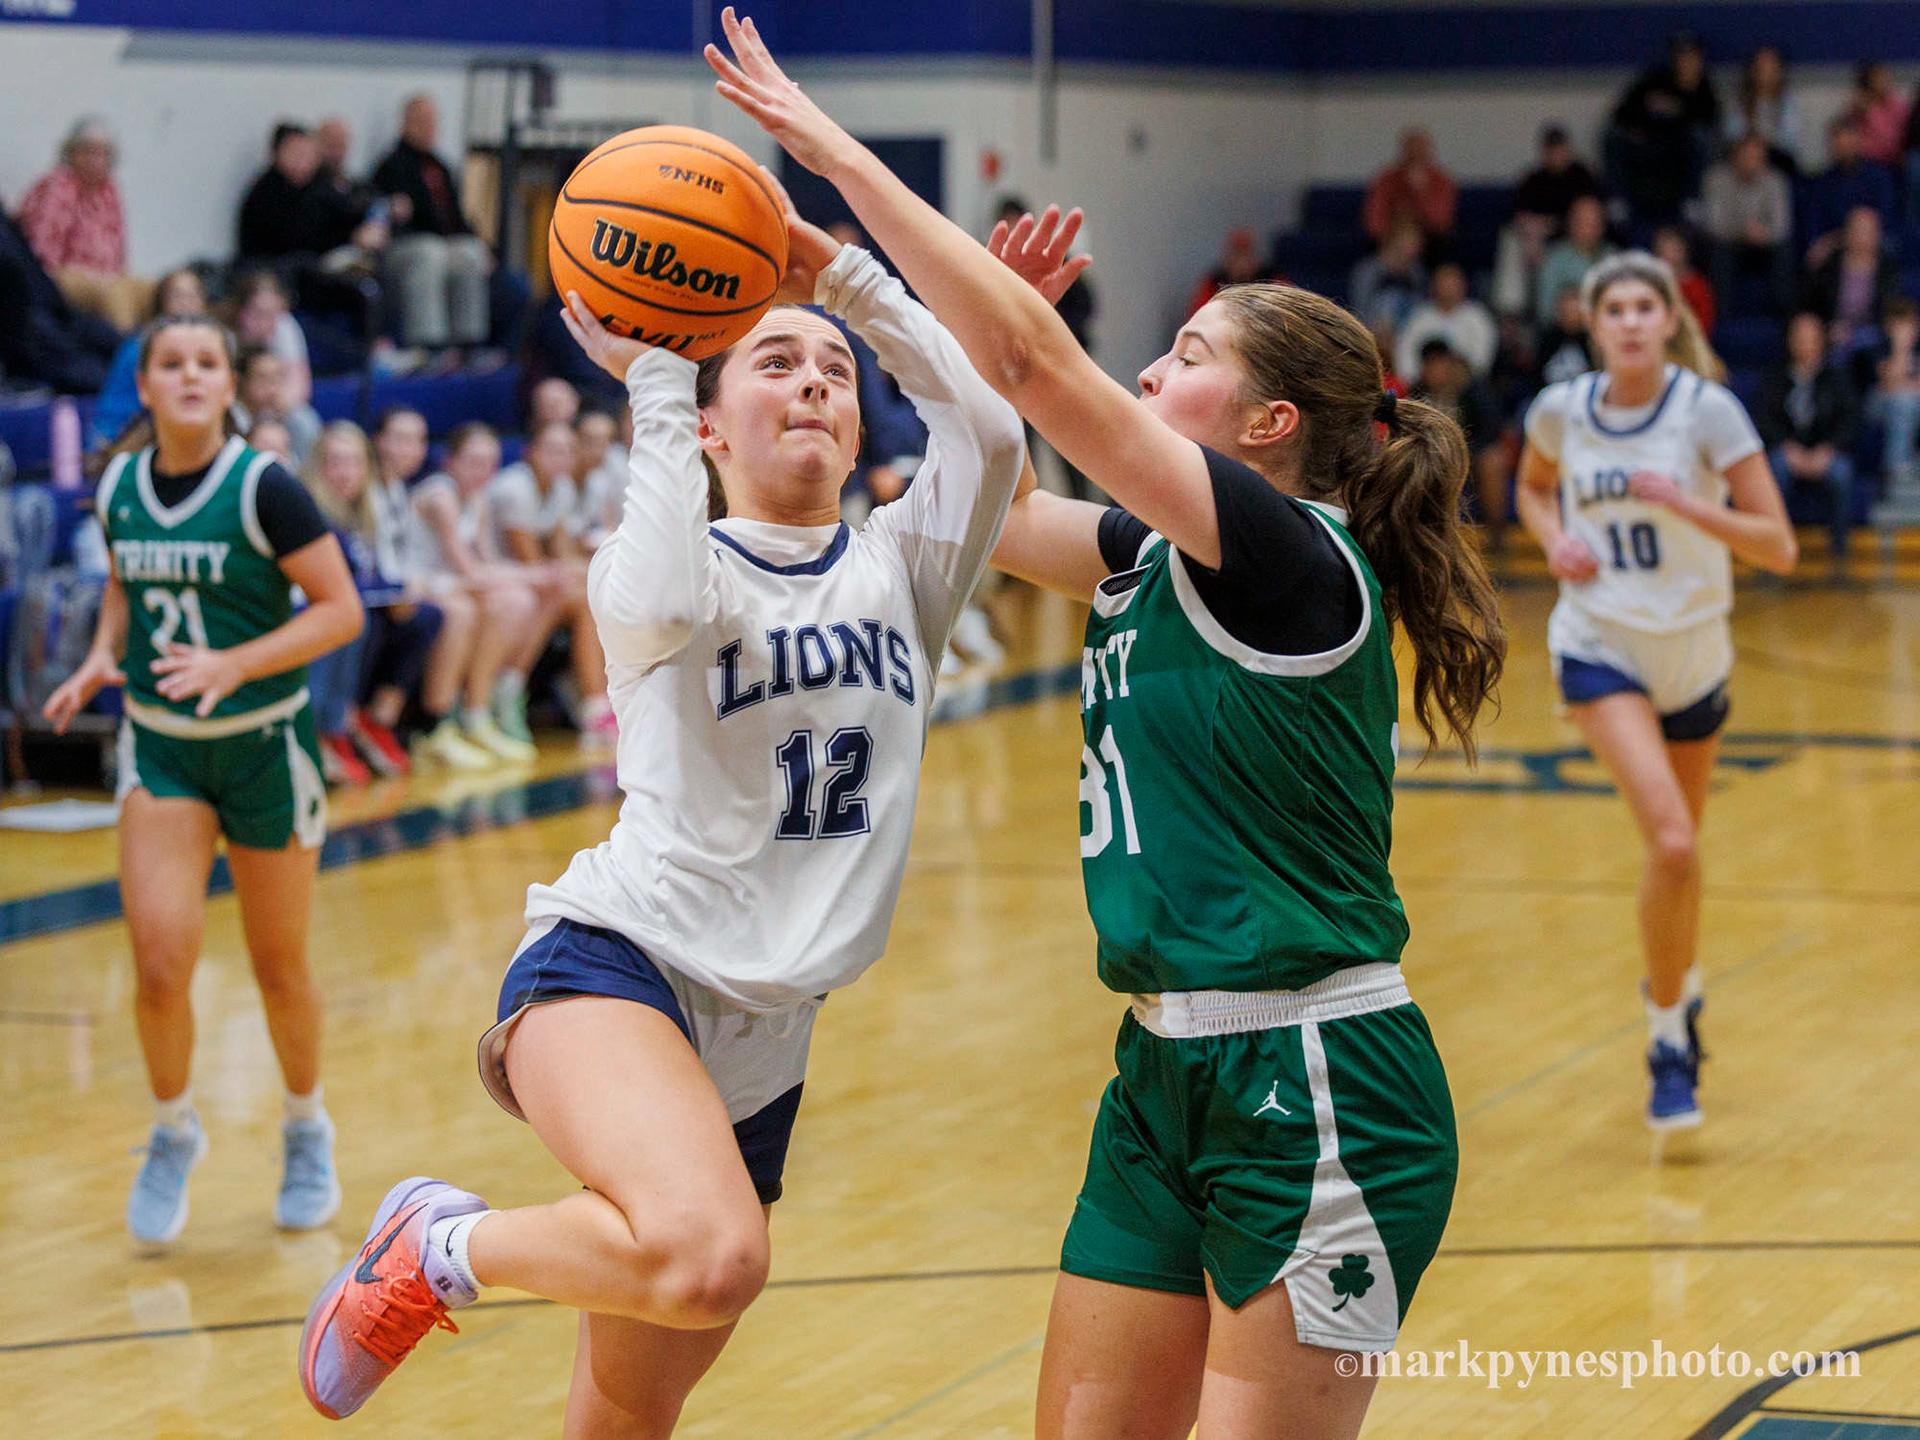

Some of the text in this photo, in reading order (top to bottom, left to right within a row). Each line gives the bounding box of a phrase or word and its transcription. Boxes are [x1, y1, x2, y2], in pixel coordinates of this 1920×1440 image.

[590, 218, 741, 301] Wilson
[112, 540, 232, 583] TRINITY
[1607, 522, 1660, 571] 10
[142, 587, 209, 658] 21
[717, 618, 916, 721] LIONS
[774, 726, 875, 841] 12
